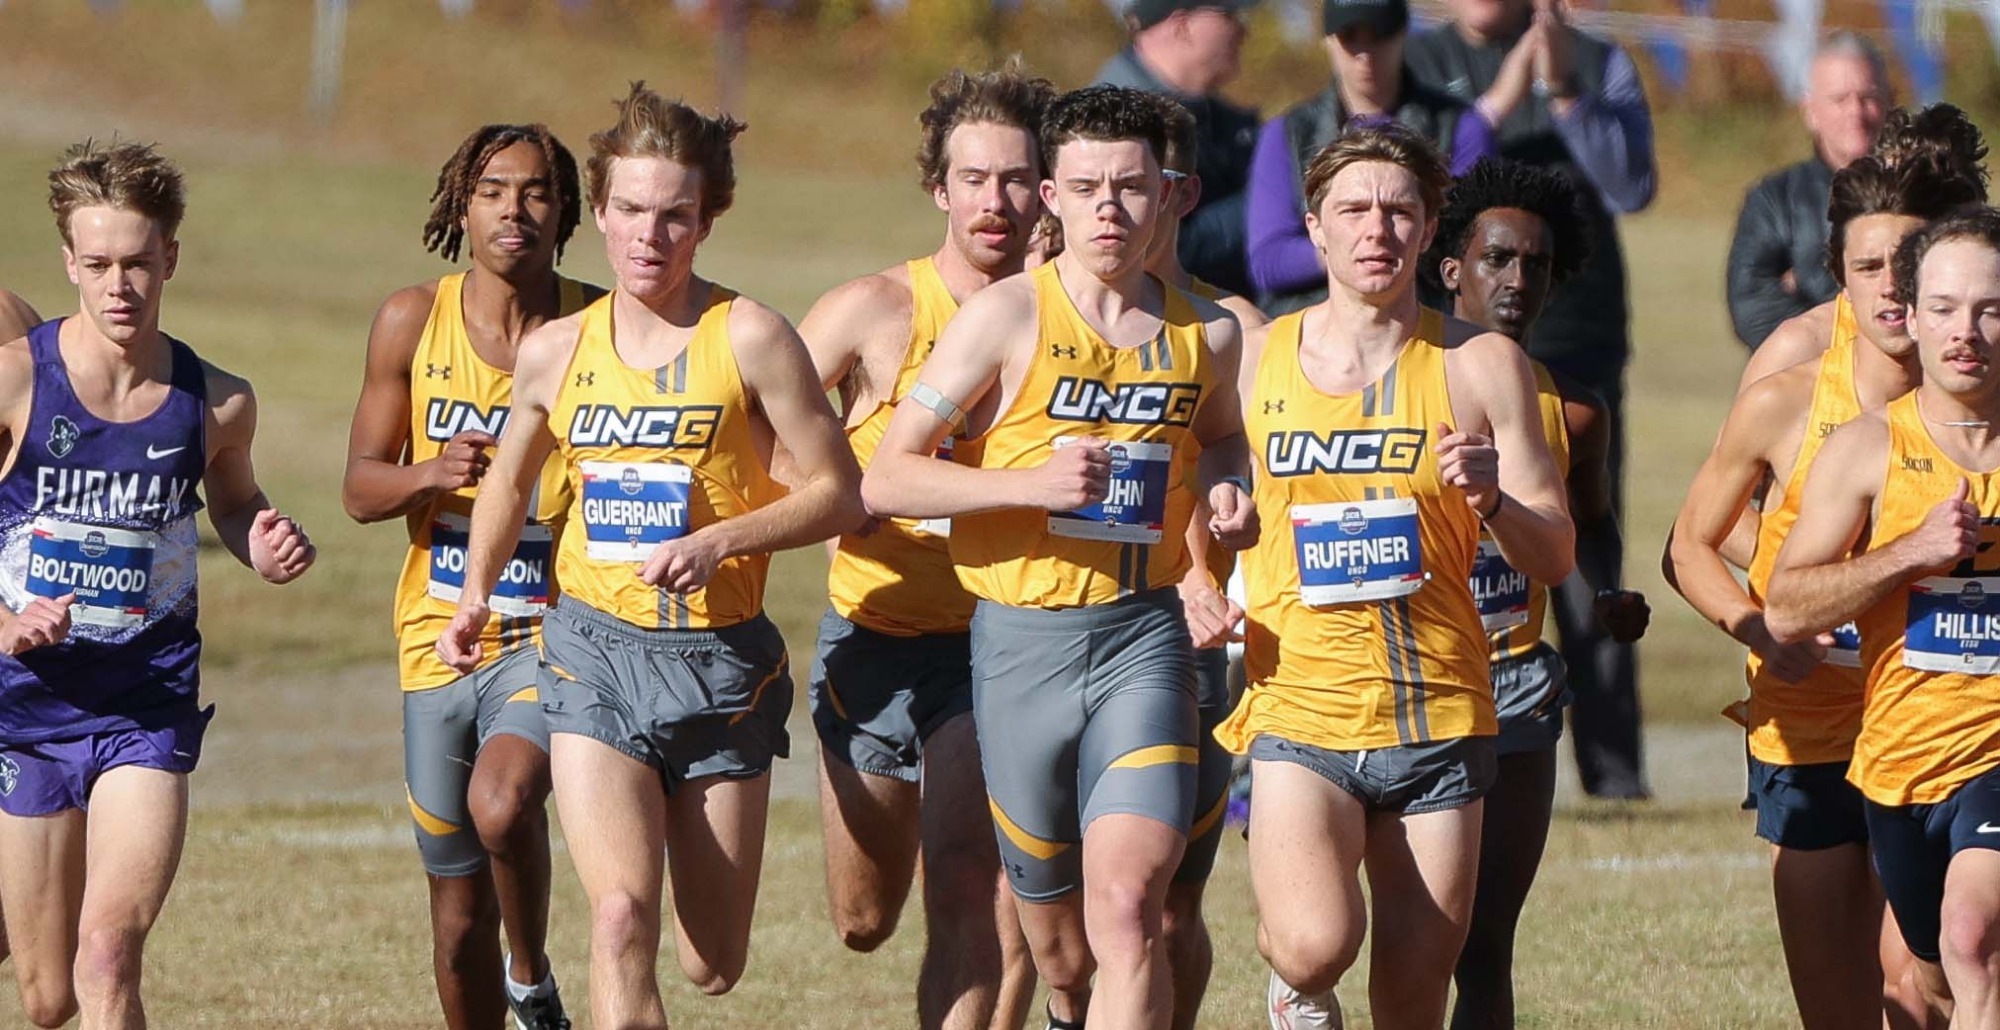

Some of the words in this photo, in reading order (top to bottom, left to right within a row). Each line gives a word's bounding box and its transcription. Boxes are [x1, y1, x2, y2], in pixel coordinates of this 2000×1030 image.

[426, 397, 511, 442] UN
[1046, 376, 1202, 427] UNCG
[568, 404, 723, 448] UNCG
[1267, 428, 1427, 477] UNCG
[1902, 455, 1933, 473] SOCON
[34, 466, 190, 522] FURMAN
[584, 498, 684, 527] GUERRANT
[30, 553, 147, 593] BOLTWOOD
[1303, 536, 1410, 570] RUFFNER
